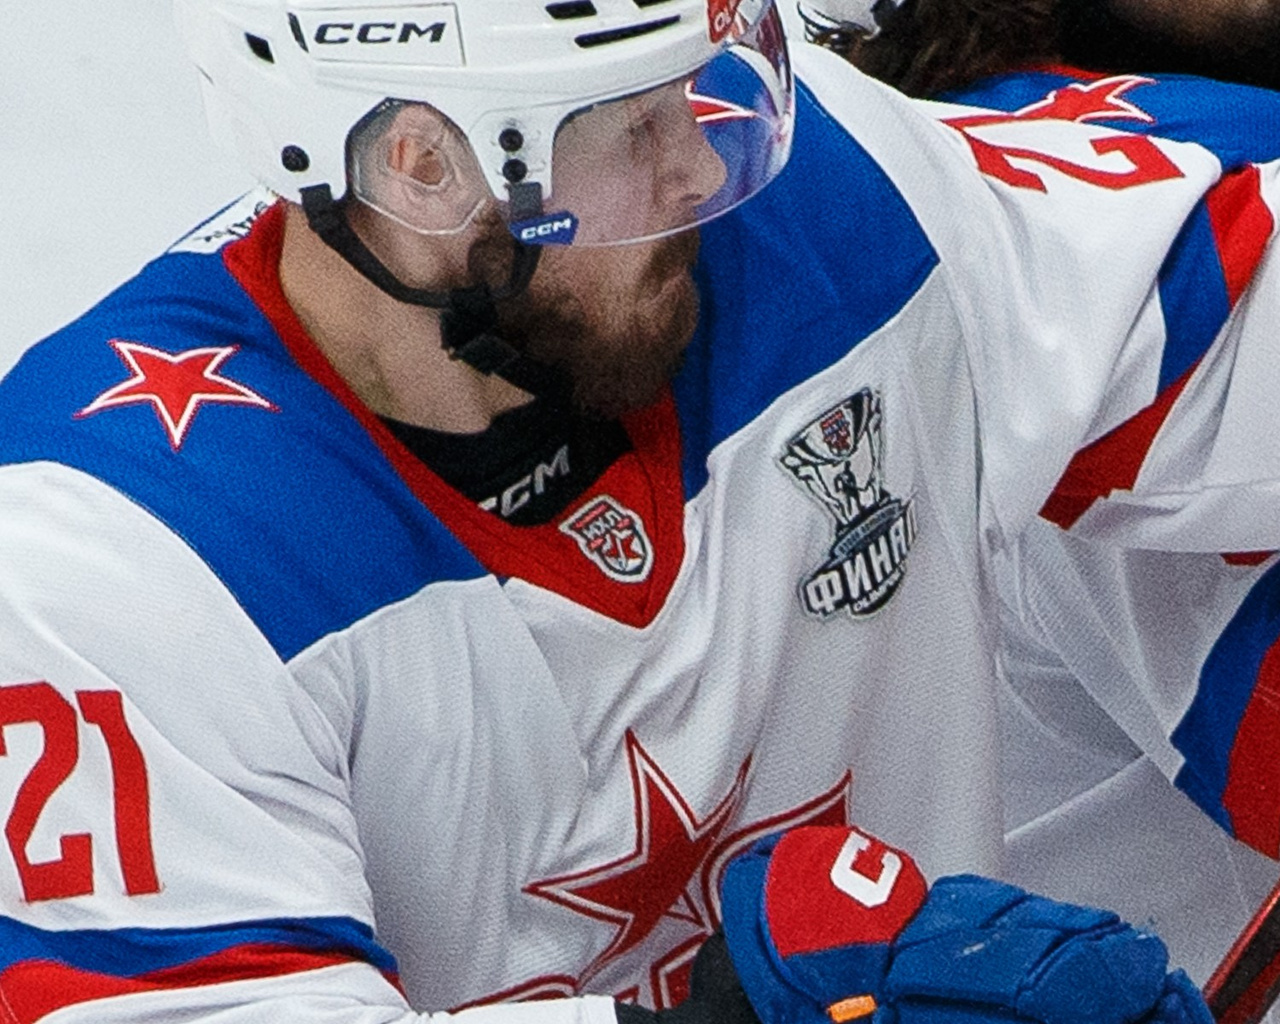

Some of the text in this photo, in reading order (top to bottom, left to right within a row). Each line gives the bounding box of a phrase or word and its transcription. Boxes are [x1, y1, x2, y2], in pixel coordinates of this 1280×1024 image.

[315, 22, 447, 45] CCM
[521, 218, 572, 240] CCM
[0, 682, 161, 903] 21
